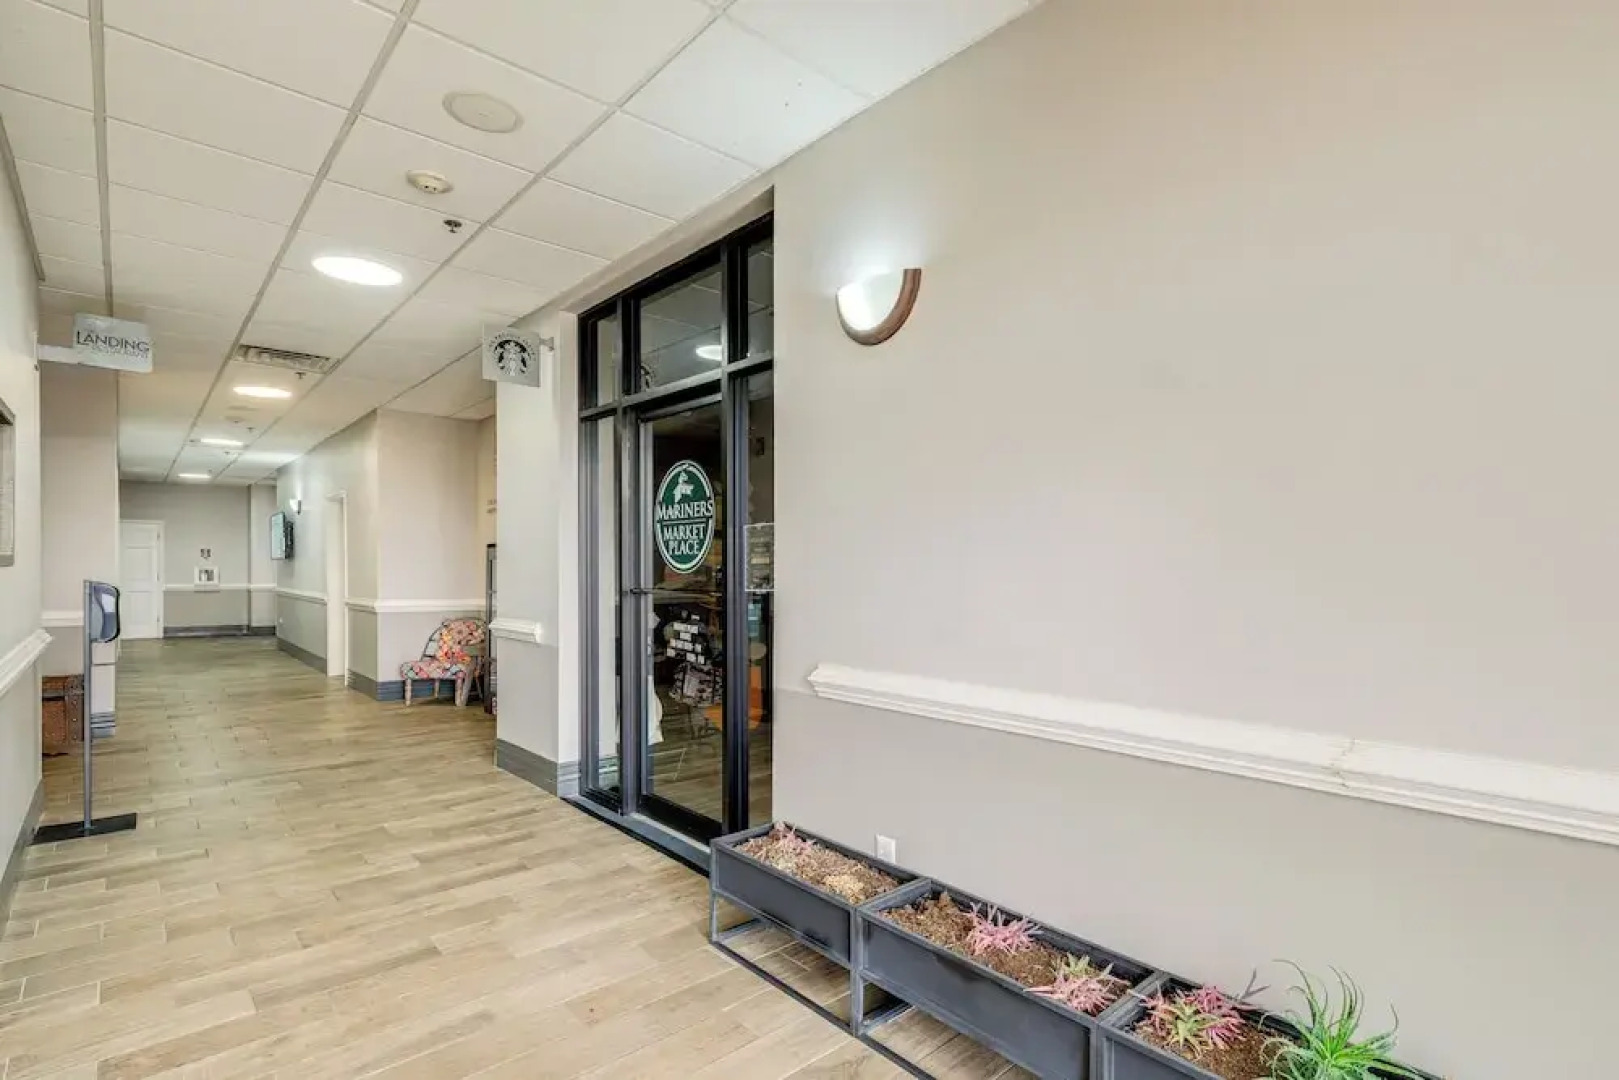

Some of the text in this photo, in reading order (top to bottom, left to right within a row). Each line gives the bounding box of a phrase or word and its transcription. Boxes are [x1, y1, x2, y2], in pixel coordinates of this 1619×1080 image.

[76, 329, 150, 352] LANDING
[658, 501, 713, 520] MARINERS
[663, 524, 706, 540] MARKET
[668, 540, 700, 556] PLACE
